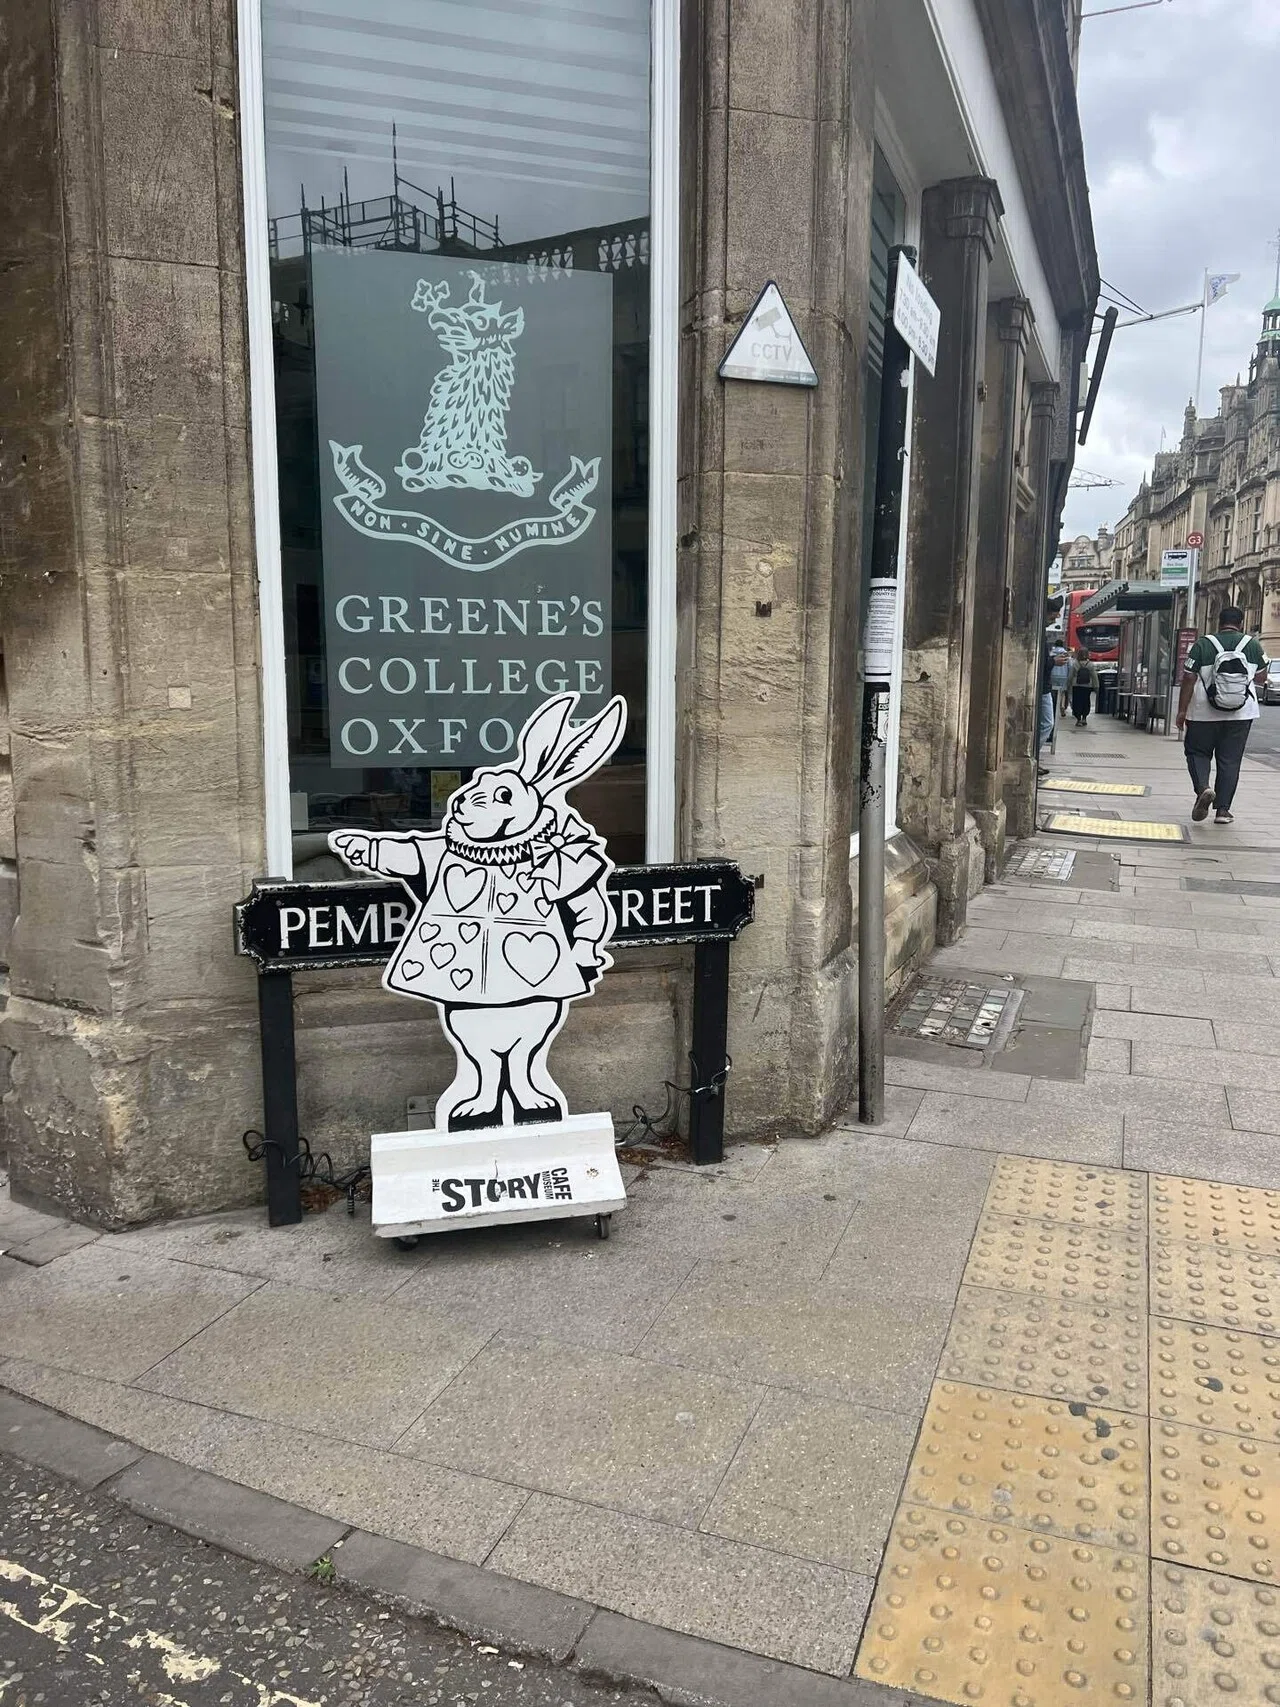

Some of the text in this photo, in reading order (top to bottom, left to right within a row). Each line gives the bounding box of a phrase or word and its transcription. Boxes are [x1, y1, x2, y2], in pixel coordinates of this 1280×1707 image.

[751, 342, 794, 362] CCTV
[350, 500, 581, 561] NON SINE NUMINE
[1187, 535, 1202, 545] G3
[335, 594, 604, 637] GREENE'S
[338, 656, 604, 695] COLLEGE
[341, 717, 593, 755] OXFO
[279, 885, 721, 949] PEMB REET
[432, 1178, 440, 1192] THE
[441, 1173, 541, 1212] STORY
[542, 1170, 554, 1200] MUSEUM
[551, 1167, 573, 1200] CAFE
